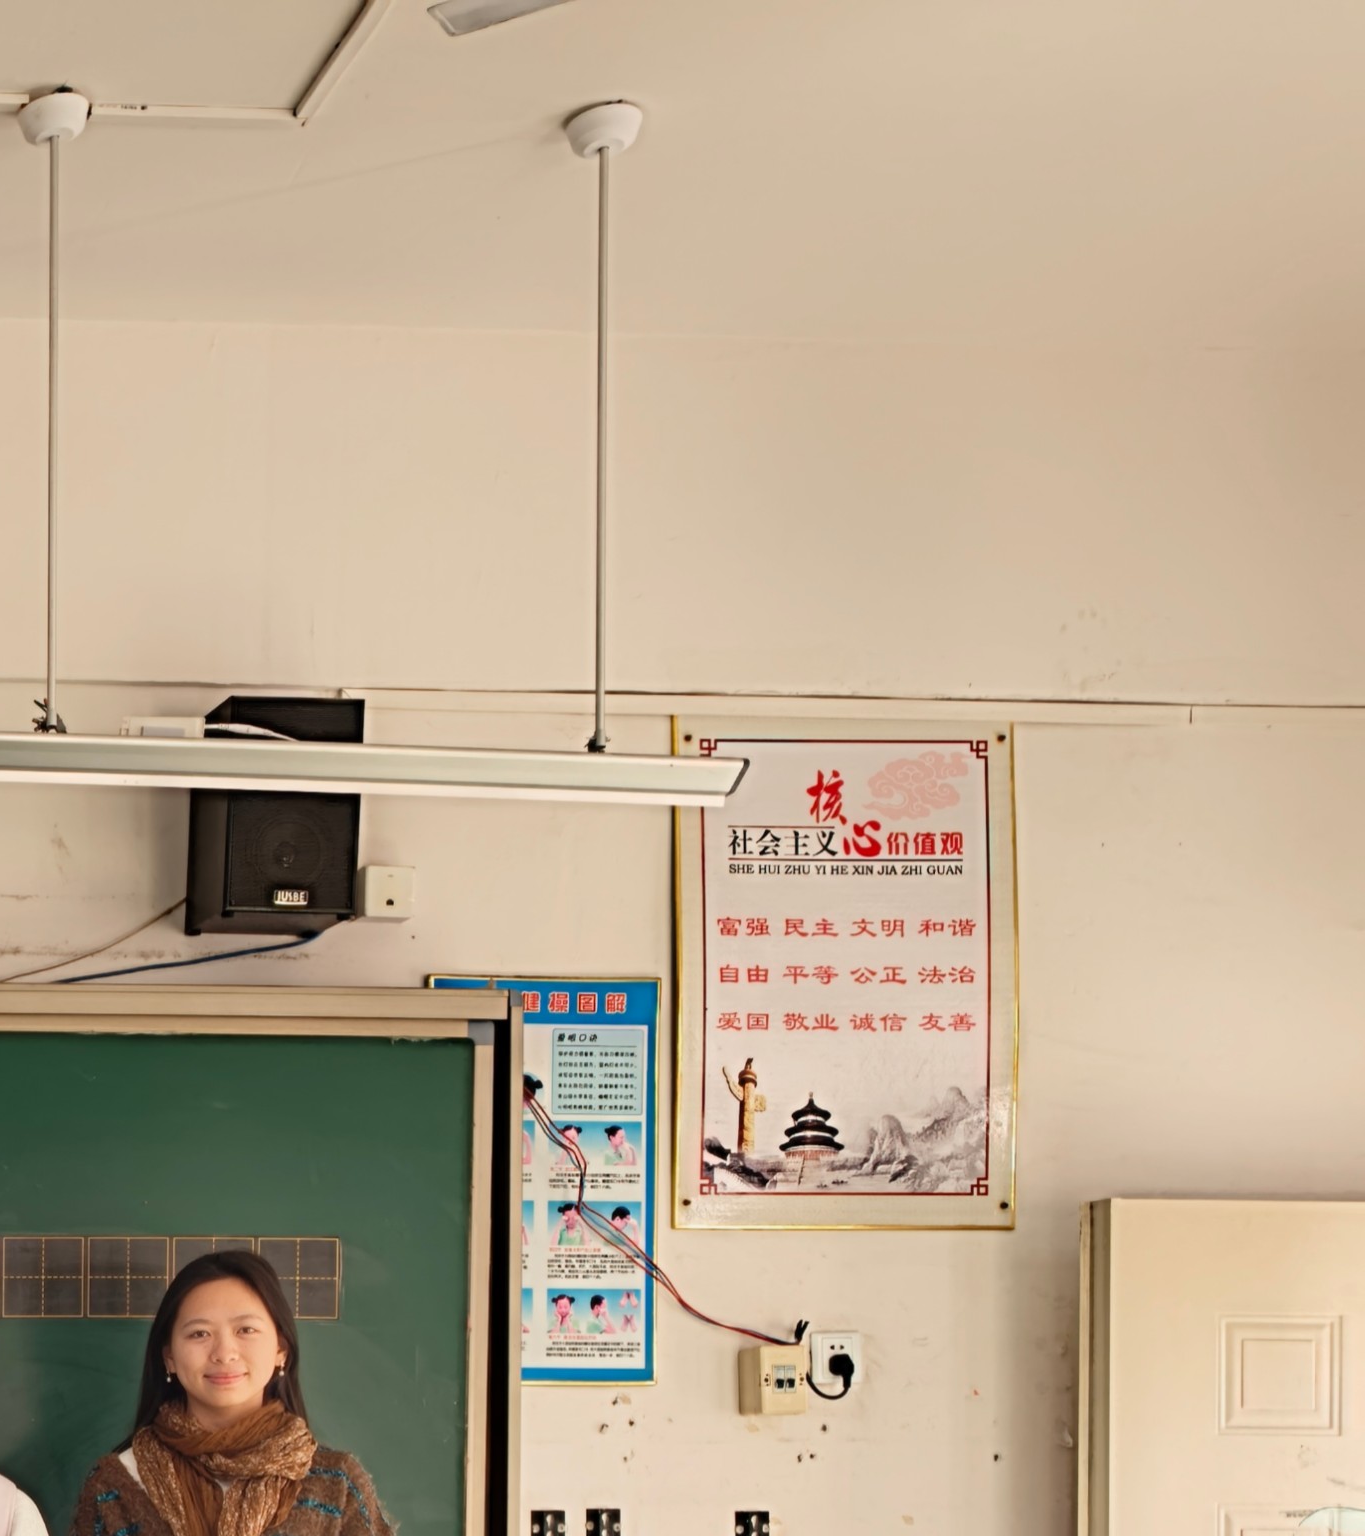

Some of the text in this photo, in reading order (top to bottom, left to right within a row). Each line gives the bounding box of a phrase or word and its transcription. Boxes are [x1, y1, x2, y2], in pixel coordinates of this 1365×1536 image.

[728, 863, 963, 876] SHE HUI ZHU YI HE XIN JIA ZHI GUAN
[717, 916, 976, 938] 富强 民主 文明 和谐
[718, 964, 976, 985] 自由 平等 公正 法治
[716, 1012, 977, 1033] 爱国 敬业 诚信 友善
